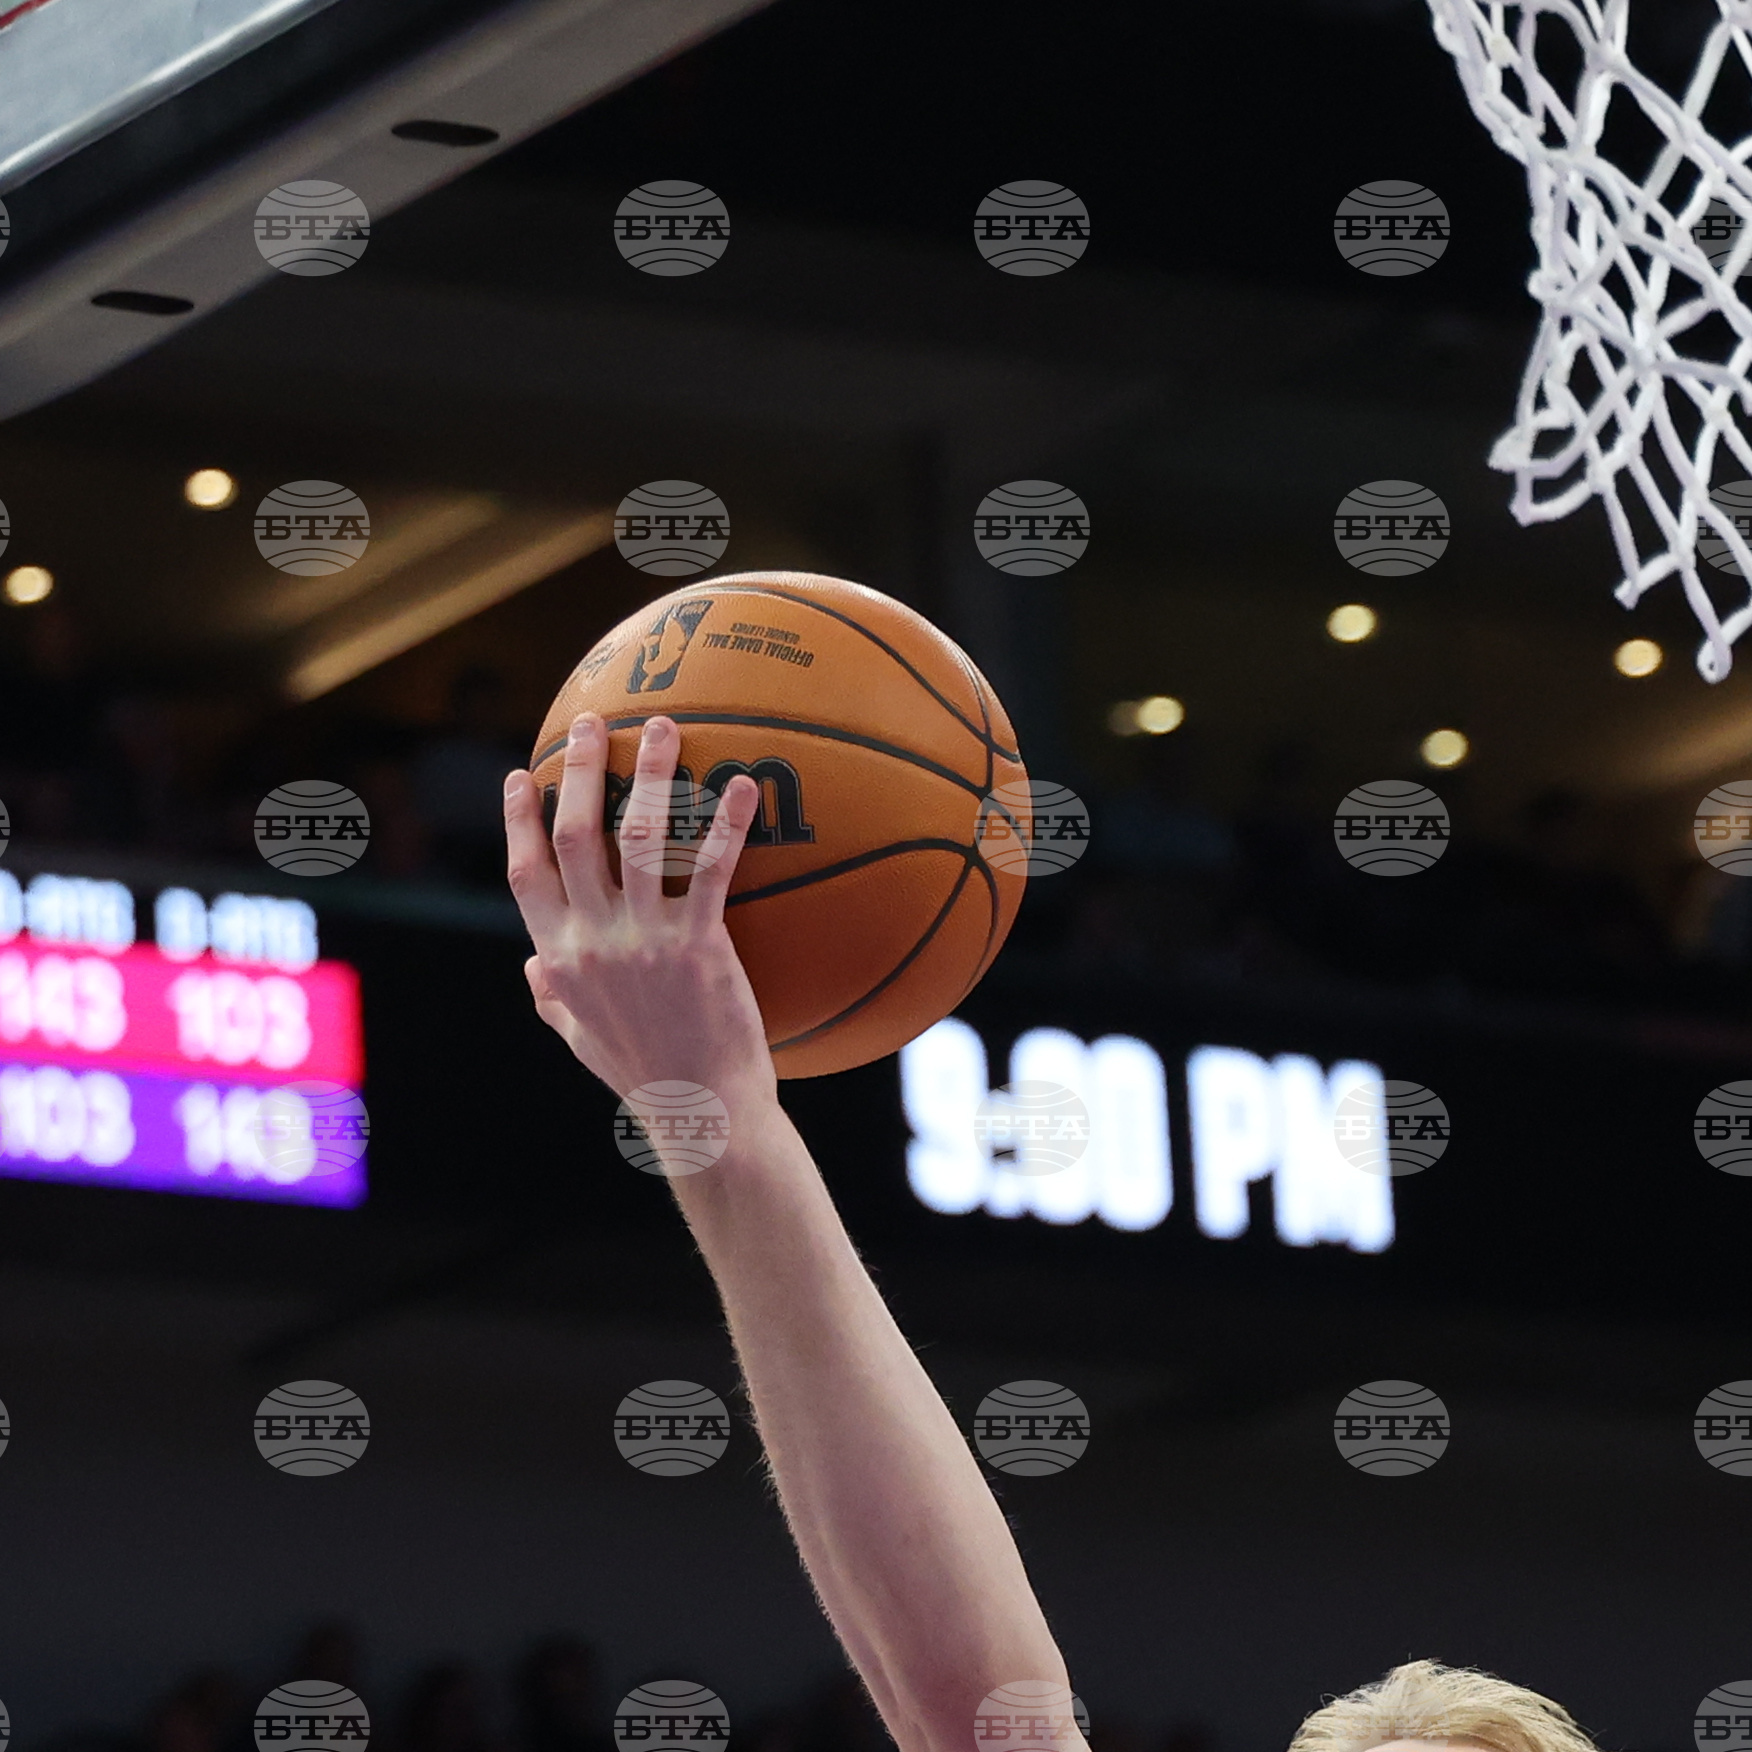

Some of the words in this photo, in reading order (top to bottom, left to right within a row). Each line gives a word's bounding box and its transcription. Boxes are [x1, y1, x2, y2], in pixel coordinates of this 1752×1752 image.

[702, 633, 732, 651] BALL
[731, 636, 764, 656] GAME
[764, 642, 814, 668] OFFICIAL
[1187, 1044, 1396, 1255] PM
